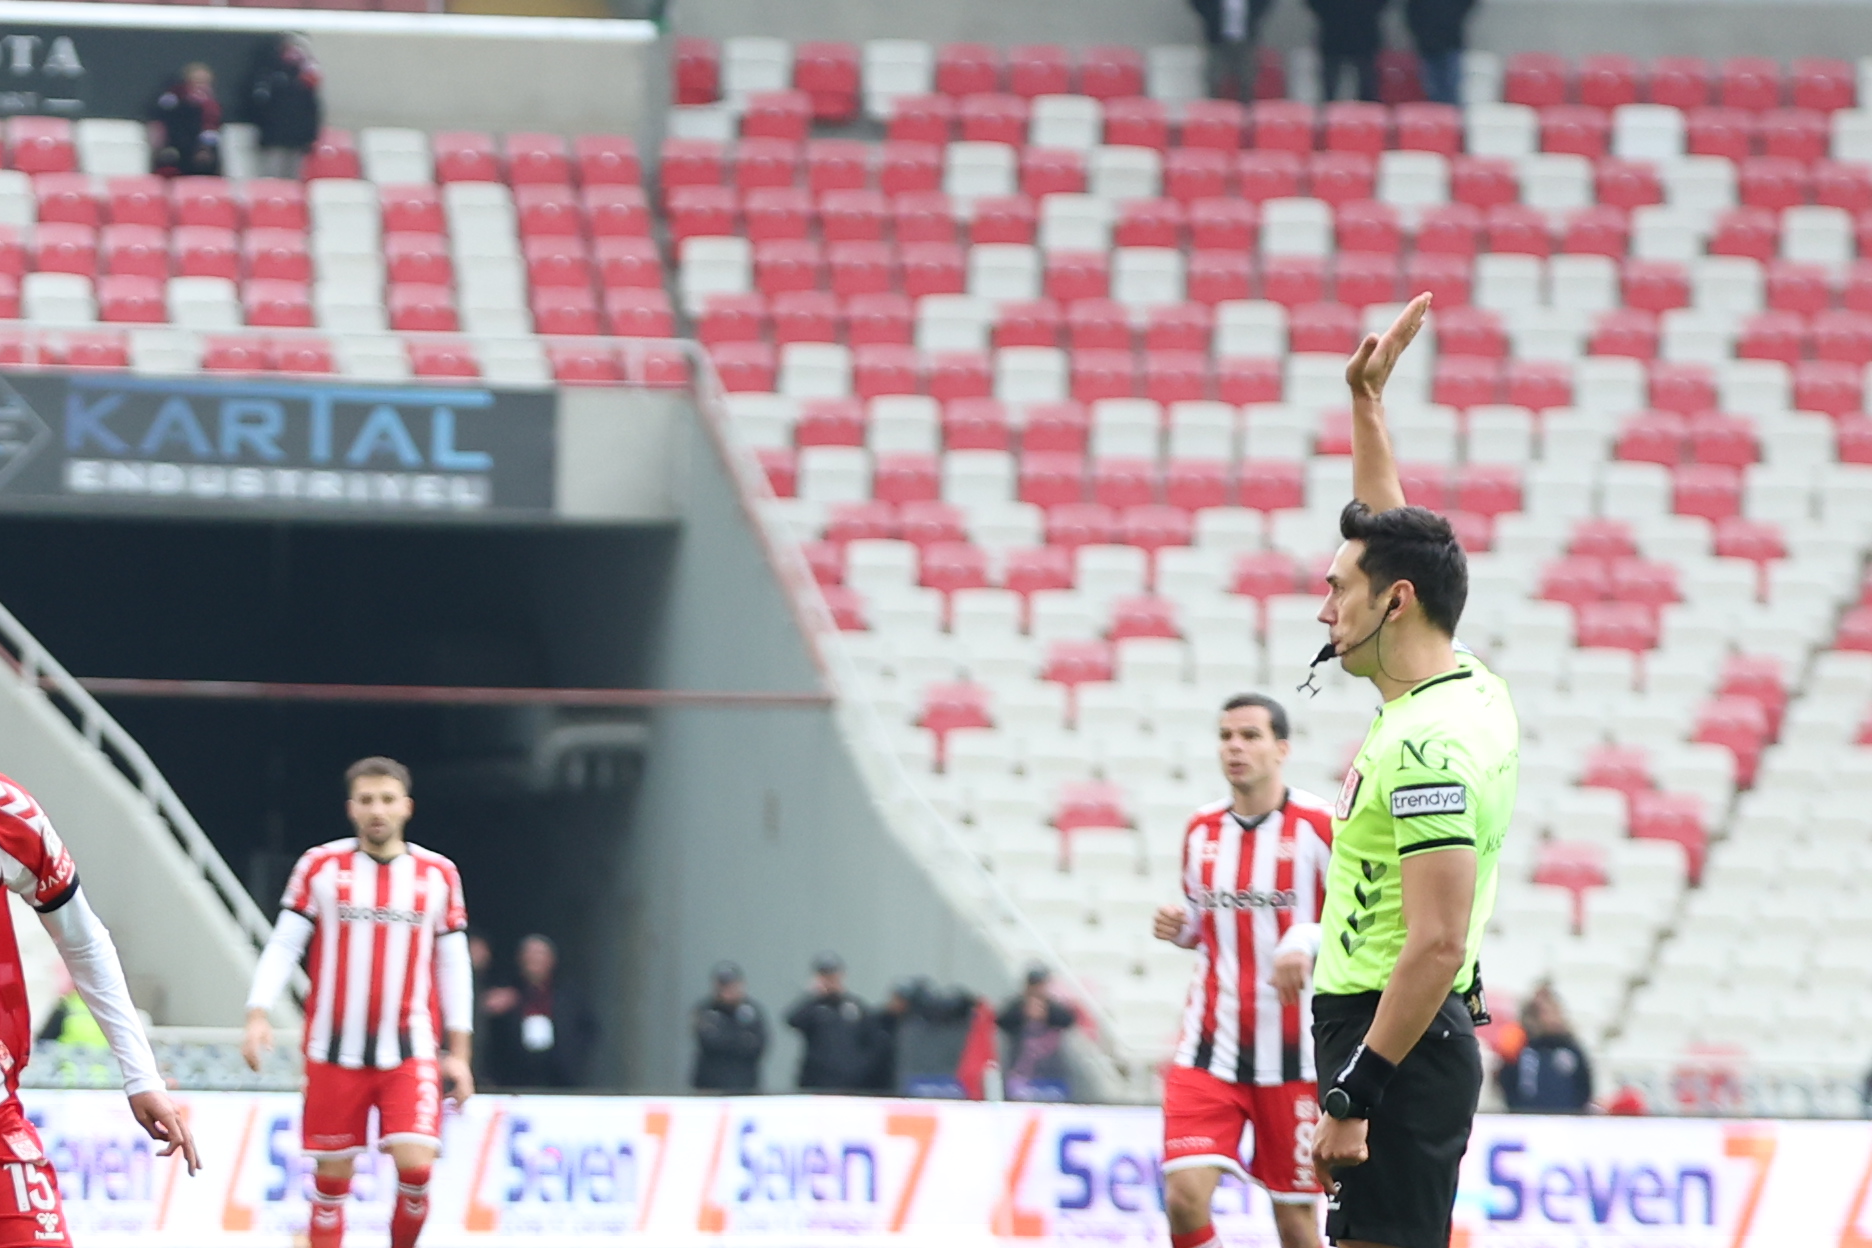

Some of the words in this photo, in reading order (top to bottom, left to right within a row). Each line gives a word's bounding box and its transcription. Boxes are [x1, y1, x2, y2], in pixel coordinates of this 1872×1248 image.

[65, 375, 495, 469] KARTAL
[1393, 788, 1465, 809] trendyol
[3, 1162, 56, 1213] 15
